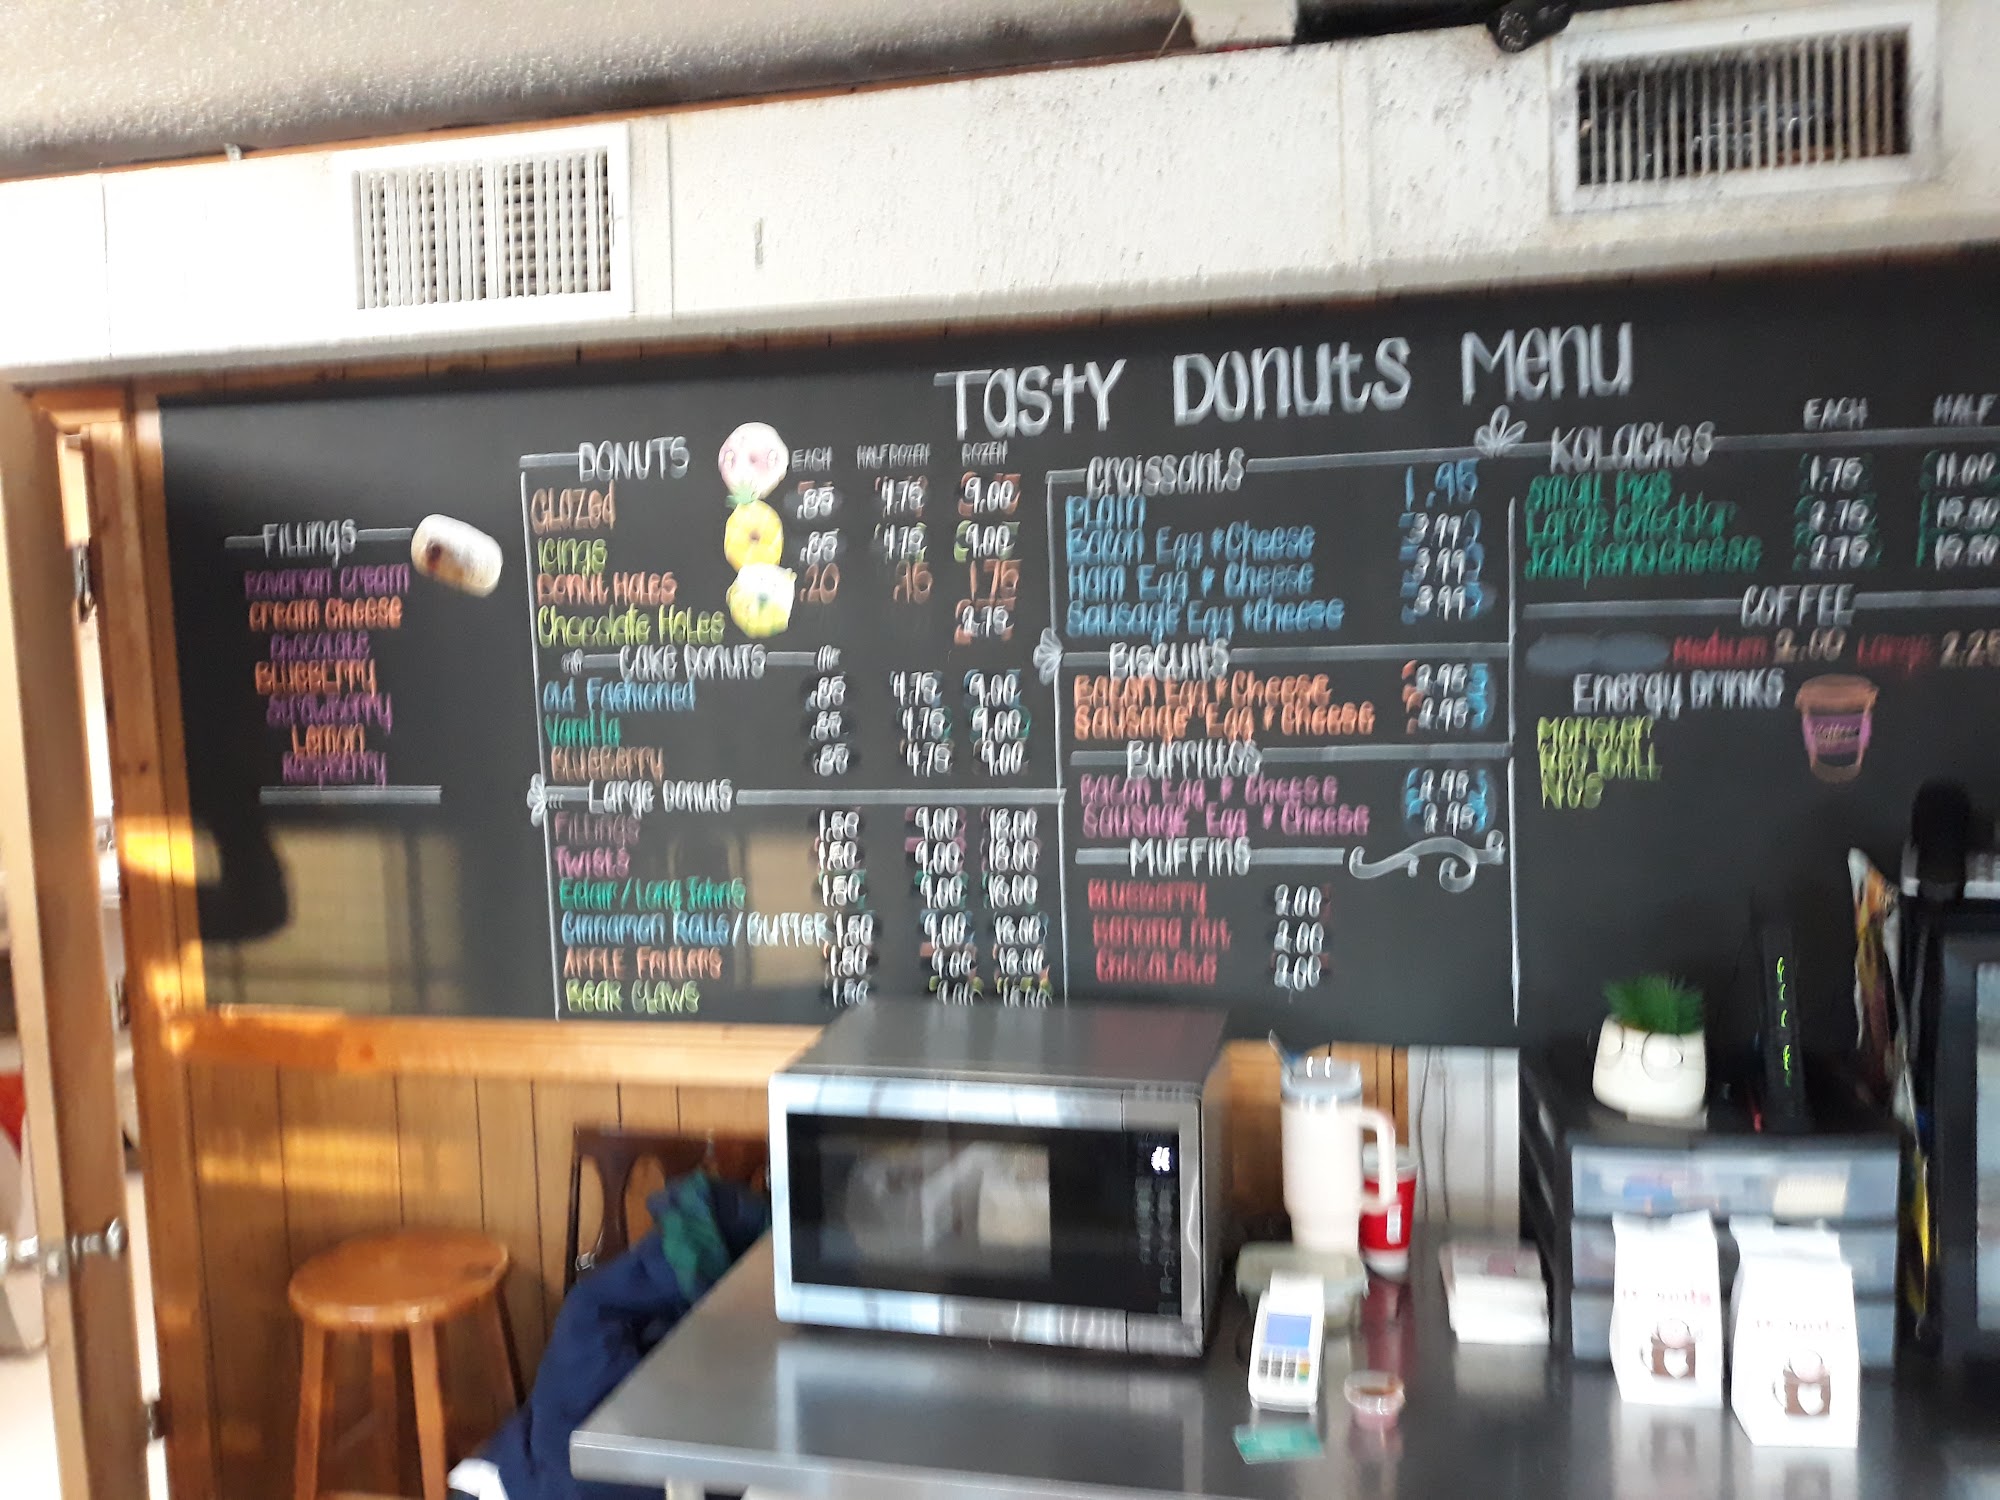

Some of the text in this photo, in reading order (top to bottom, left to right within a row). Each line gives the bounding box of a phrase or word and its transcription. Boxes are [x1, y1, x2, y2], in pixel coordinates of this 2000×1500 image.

[934, 322, 1632, 440] Tasty Donuts Menu
[1803, 397, 1868, 430] EACH
[578, 436, 690, 482] DONUTS
[791, 446, 832, 471] EACH
[962, 440, 1008, 467] DOZEN
[964, 477, 1015, 514] 9.00
[965, 523, 1011, 558] 9.00
[1741, 584, 1855, 627] COFFEE
[969, 673, 1015, 707] 9.00
[973, 707, 1021, 743] 9.00
[981, 740, 1023, 777] 9.00
[915, 806, 958, 840] 9.00
[915, 841, 960, 875] 9.00
[920, 875, 962, 910] 9.00
[924, 913, 966, 948] 9.00
